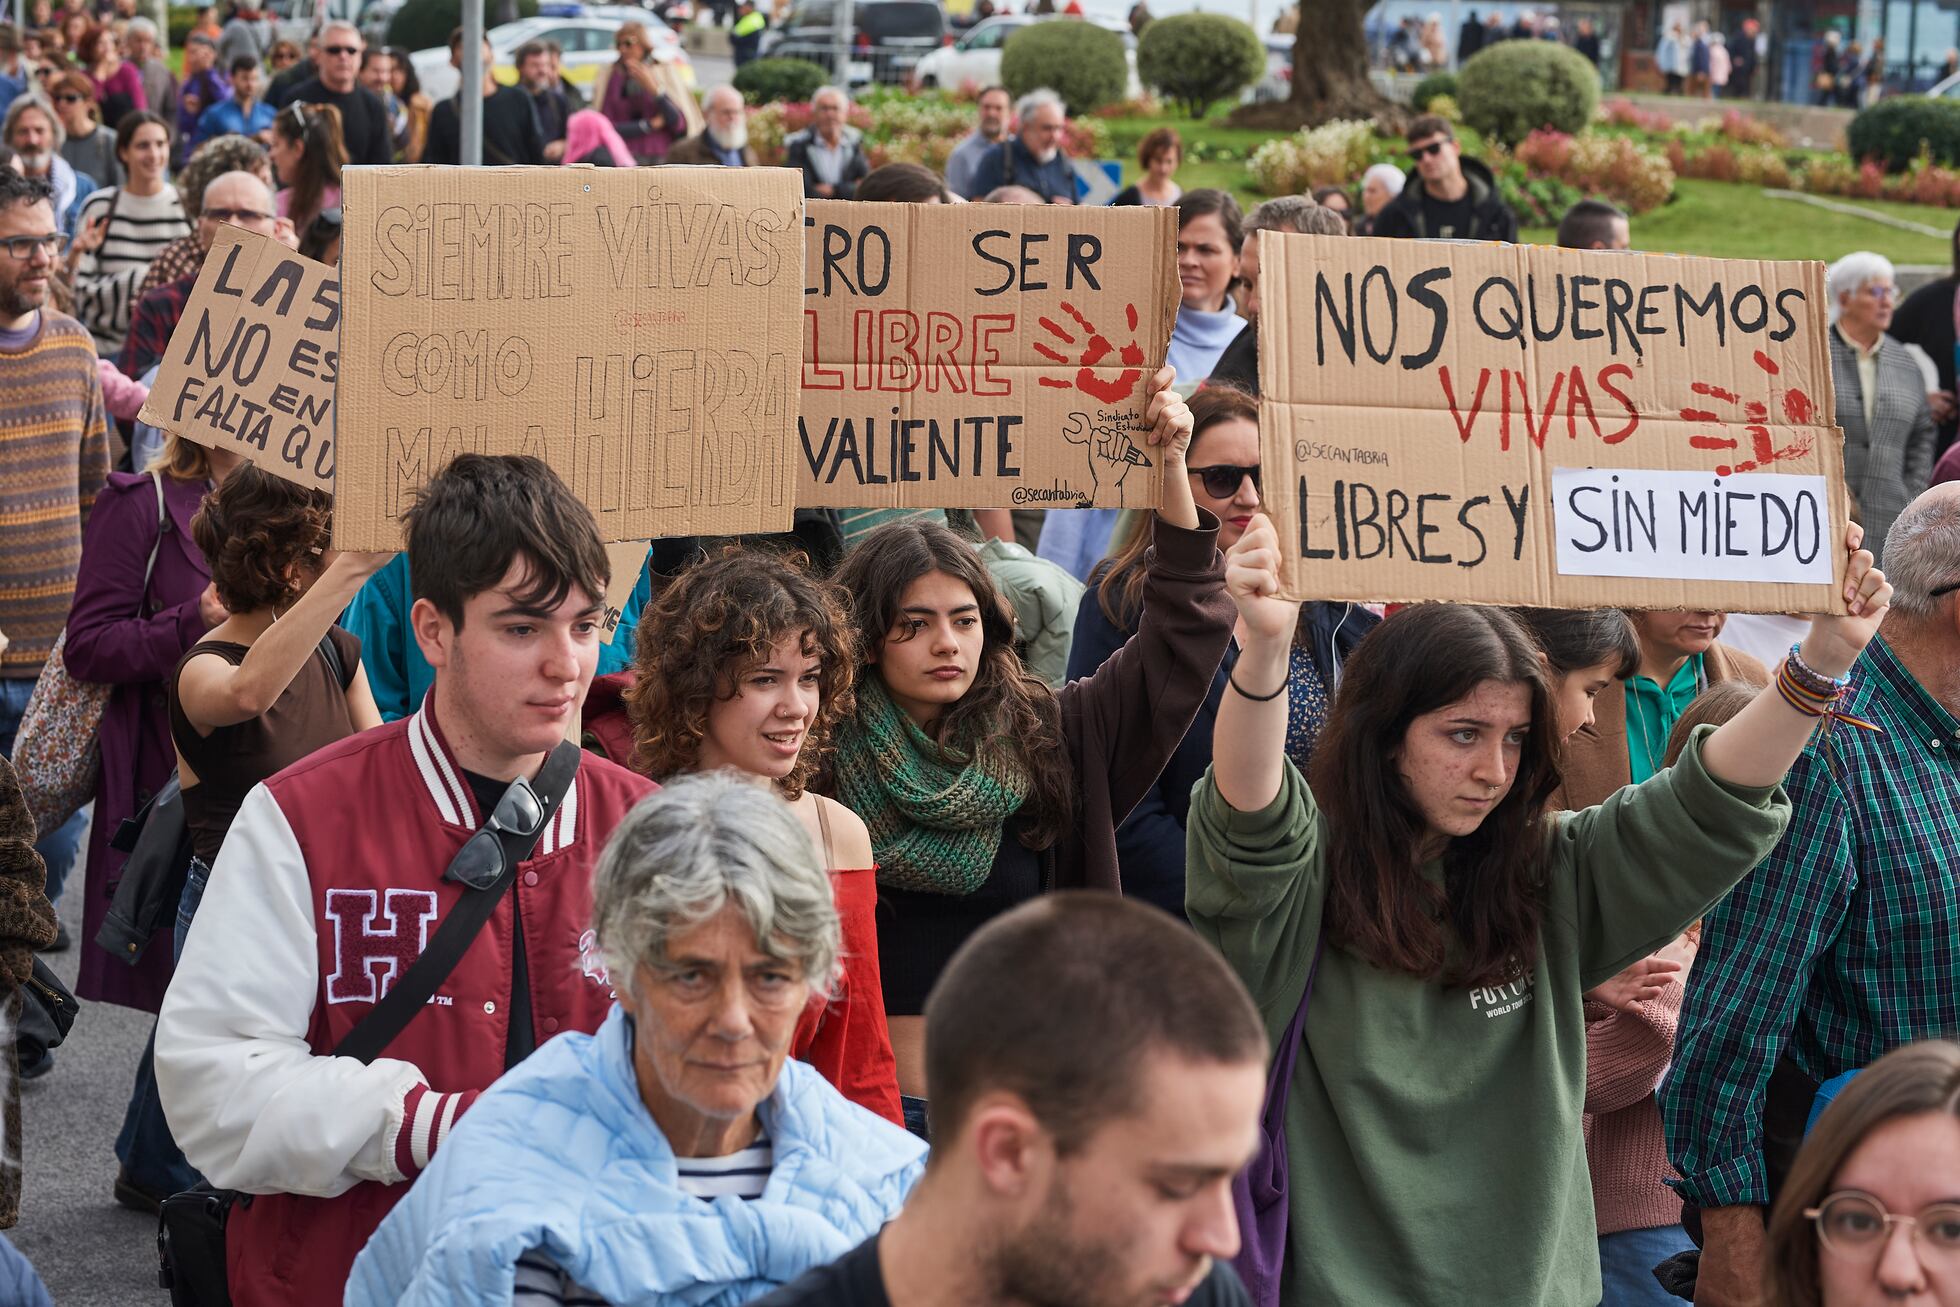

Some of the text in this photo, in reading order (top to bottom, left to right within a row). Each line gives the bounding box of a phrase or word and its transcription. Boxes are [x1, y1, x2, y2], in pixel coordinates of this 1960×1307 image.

[214, 244, 338, 331] LAS
[972, 230, 1101, 295] SER
[184, 307, 271, 387] NO
[802, 310, 1015, 396] LIBRE
[1315, 265, 1806, 370] NOS QUEREMOS
[382, 330, 533, 401] COMO
[172, 376, 273, 450] FALTA
[268, 383, 331, 426] EN
[1097, 408, 1140, 422] Sindicato
[1439, 364, 1639, 451] VIVAS
[1011, 478, 1087, 504] @secantabria
[1299, 475, 1529, 568] LIBRES Y
[325, 888, 438, 1005] H
[1486, 1004, 1511, 1019] WORLD
